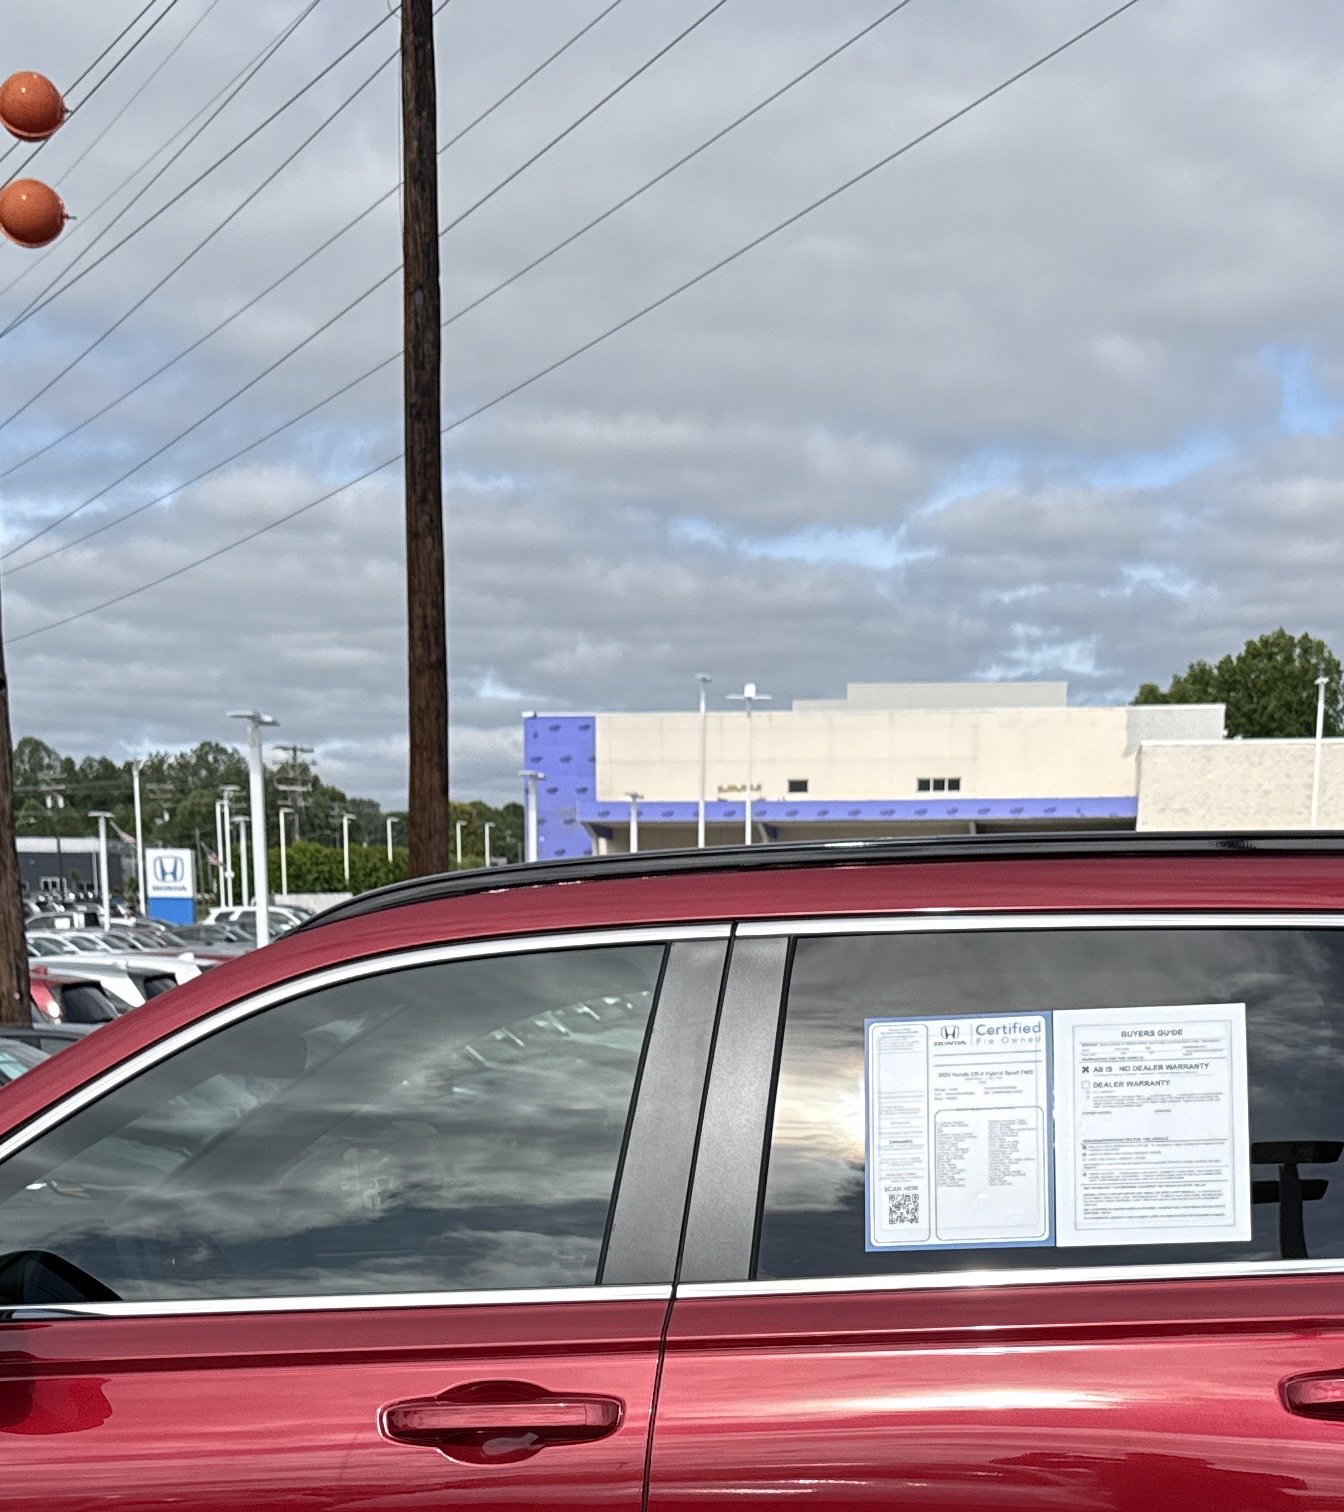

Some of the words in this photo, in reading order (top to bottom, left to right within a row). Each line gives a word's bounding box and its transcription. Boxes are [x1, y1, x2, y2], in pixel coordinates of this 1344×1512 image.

[975, 1021, 1042, 1036] Certified
[1121, 1030, 1155, 1038] BUYERS
[1157, 1028, 1184, 1037] GUIDE
[1165, 1063, 1210, 1071] WARRANTY
[1093, 1081, 1125, 1089] DEALER
[1126, 1079, 1171, 1088] WARRANTY
